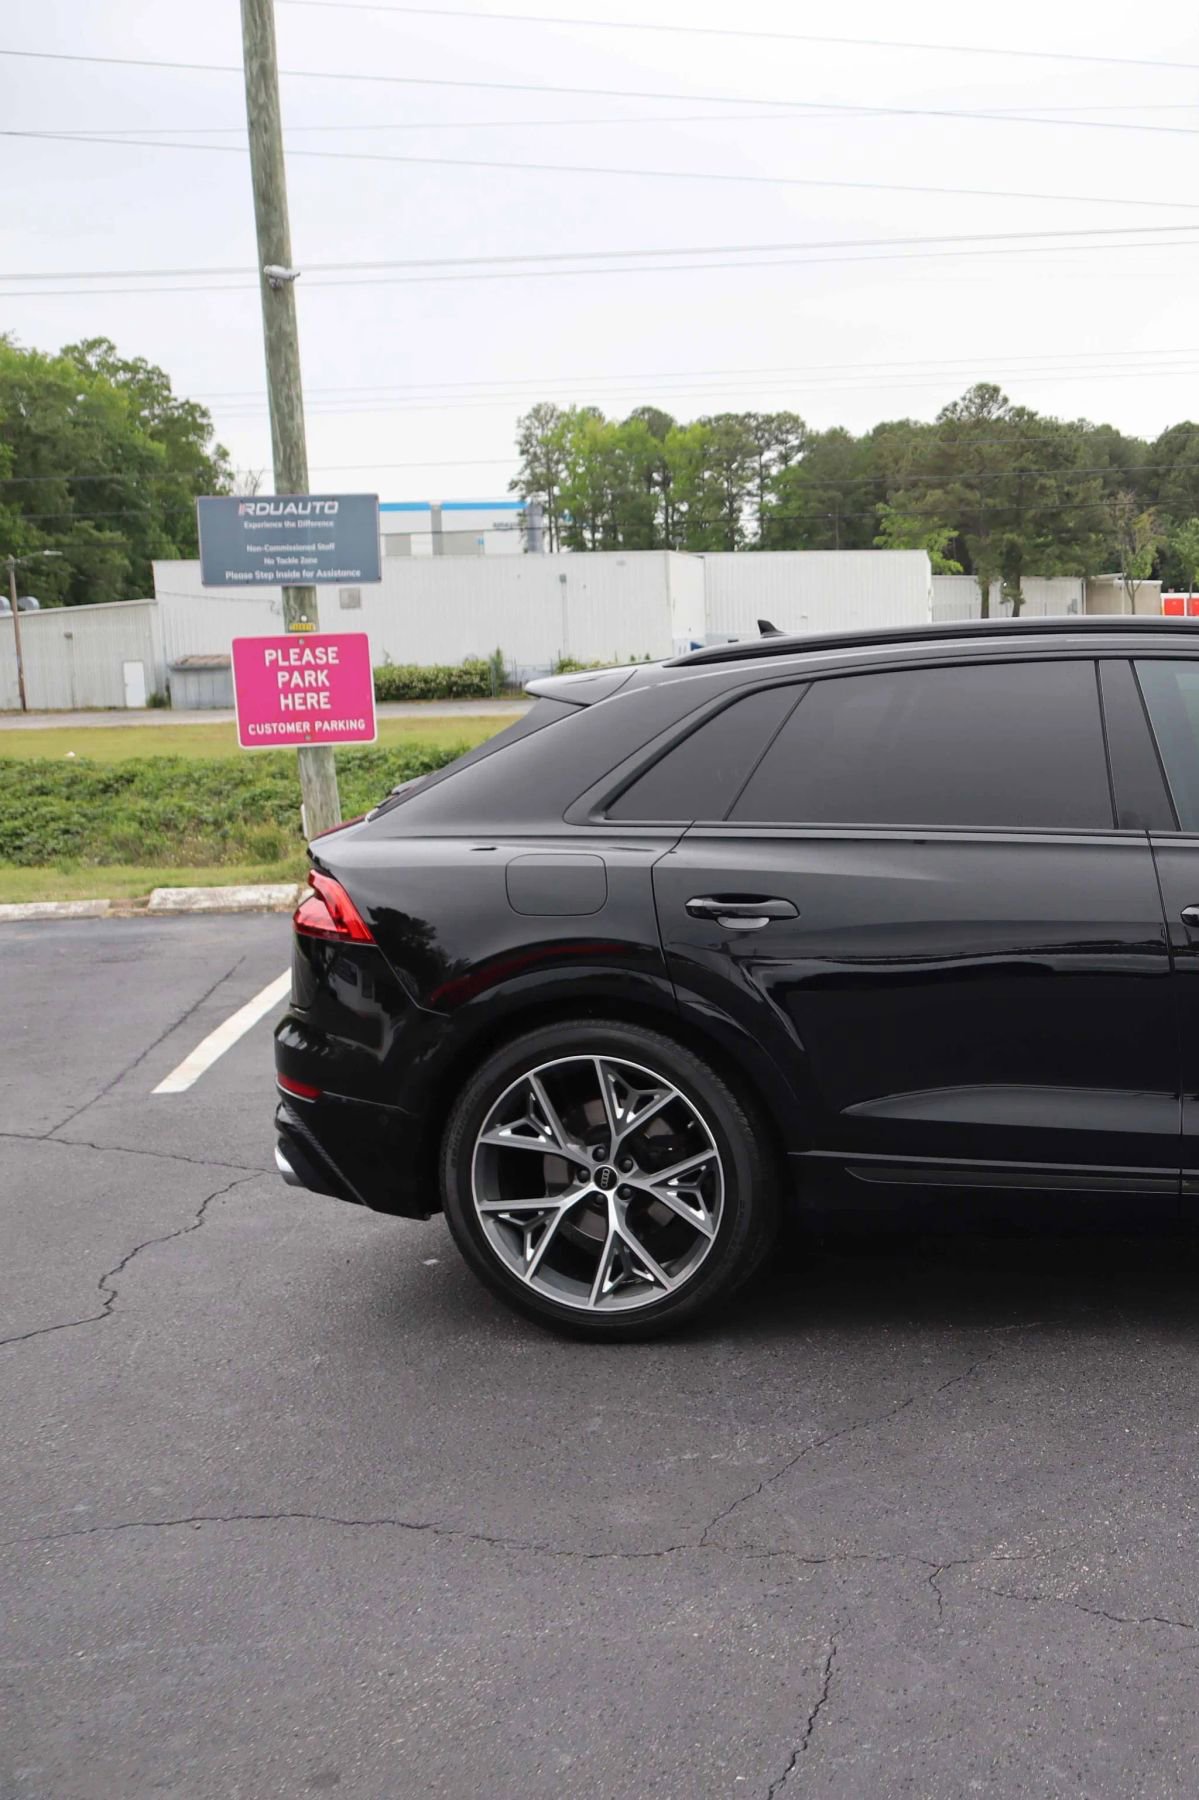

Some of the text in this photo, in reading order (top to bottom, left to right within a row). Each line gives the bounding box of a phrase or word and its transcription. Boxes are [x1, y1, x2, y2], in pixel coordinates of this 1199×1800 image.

[244, 518, 334, 529] Experience the Difference
[246, 542, 335, 553] Non-Commissioned Staff
[263, 557, 274, 565] No
[300, 556, 318, 564] Zone
[225, 568, 361, 580] Please Step Inside for Assistance
[264, 647, 339, 666] PLEASE
[277, 670, 330, 688] PARK
[279, 691, 331, 711] HERE
[248, 719, 366, 735] CUSTOMER PARKING
